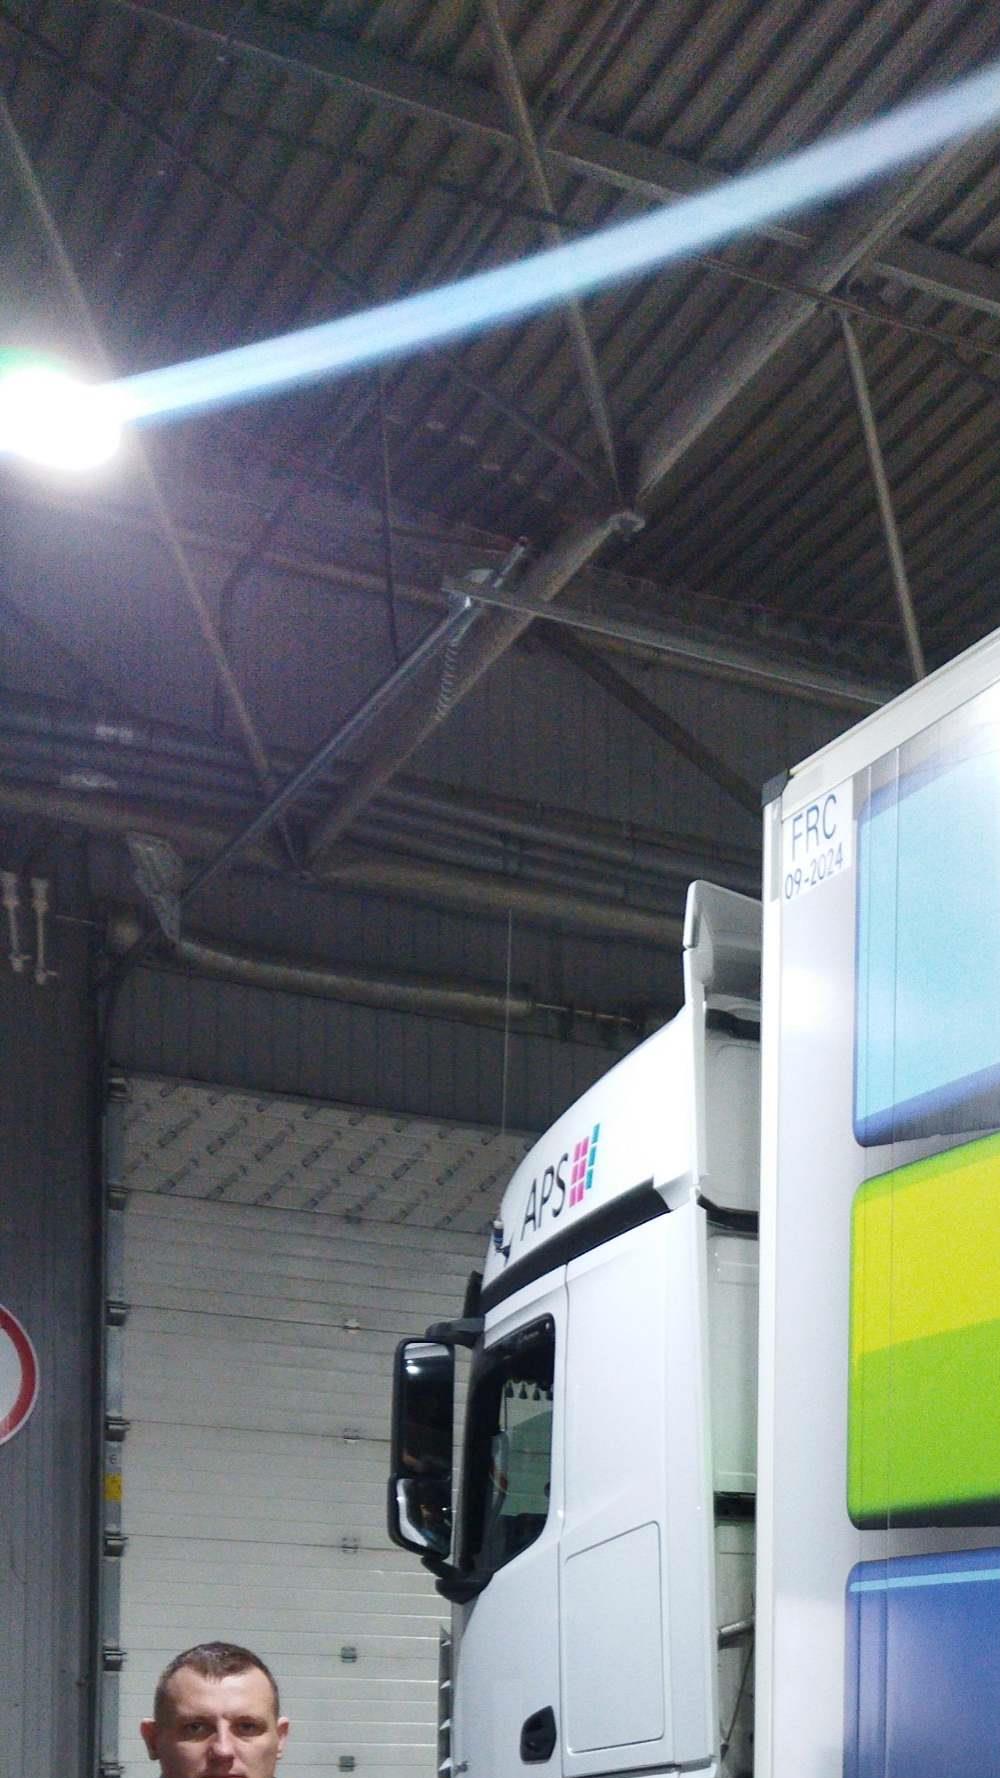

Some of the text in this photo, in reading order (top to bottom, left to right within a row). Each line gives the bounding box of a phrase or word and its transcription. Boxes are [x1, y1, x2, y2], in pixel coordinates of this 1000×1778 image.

[791, 793, 838, 861] FRC
[784, 841, 844, 900] 09-2024
[520, 1152, 569, 1241] APS
